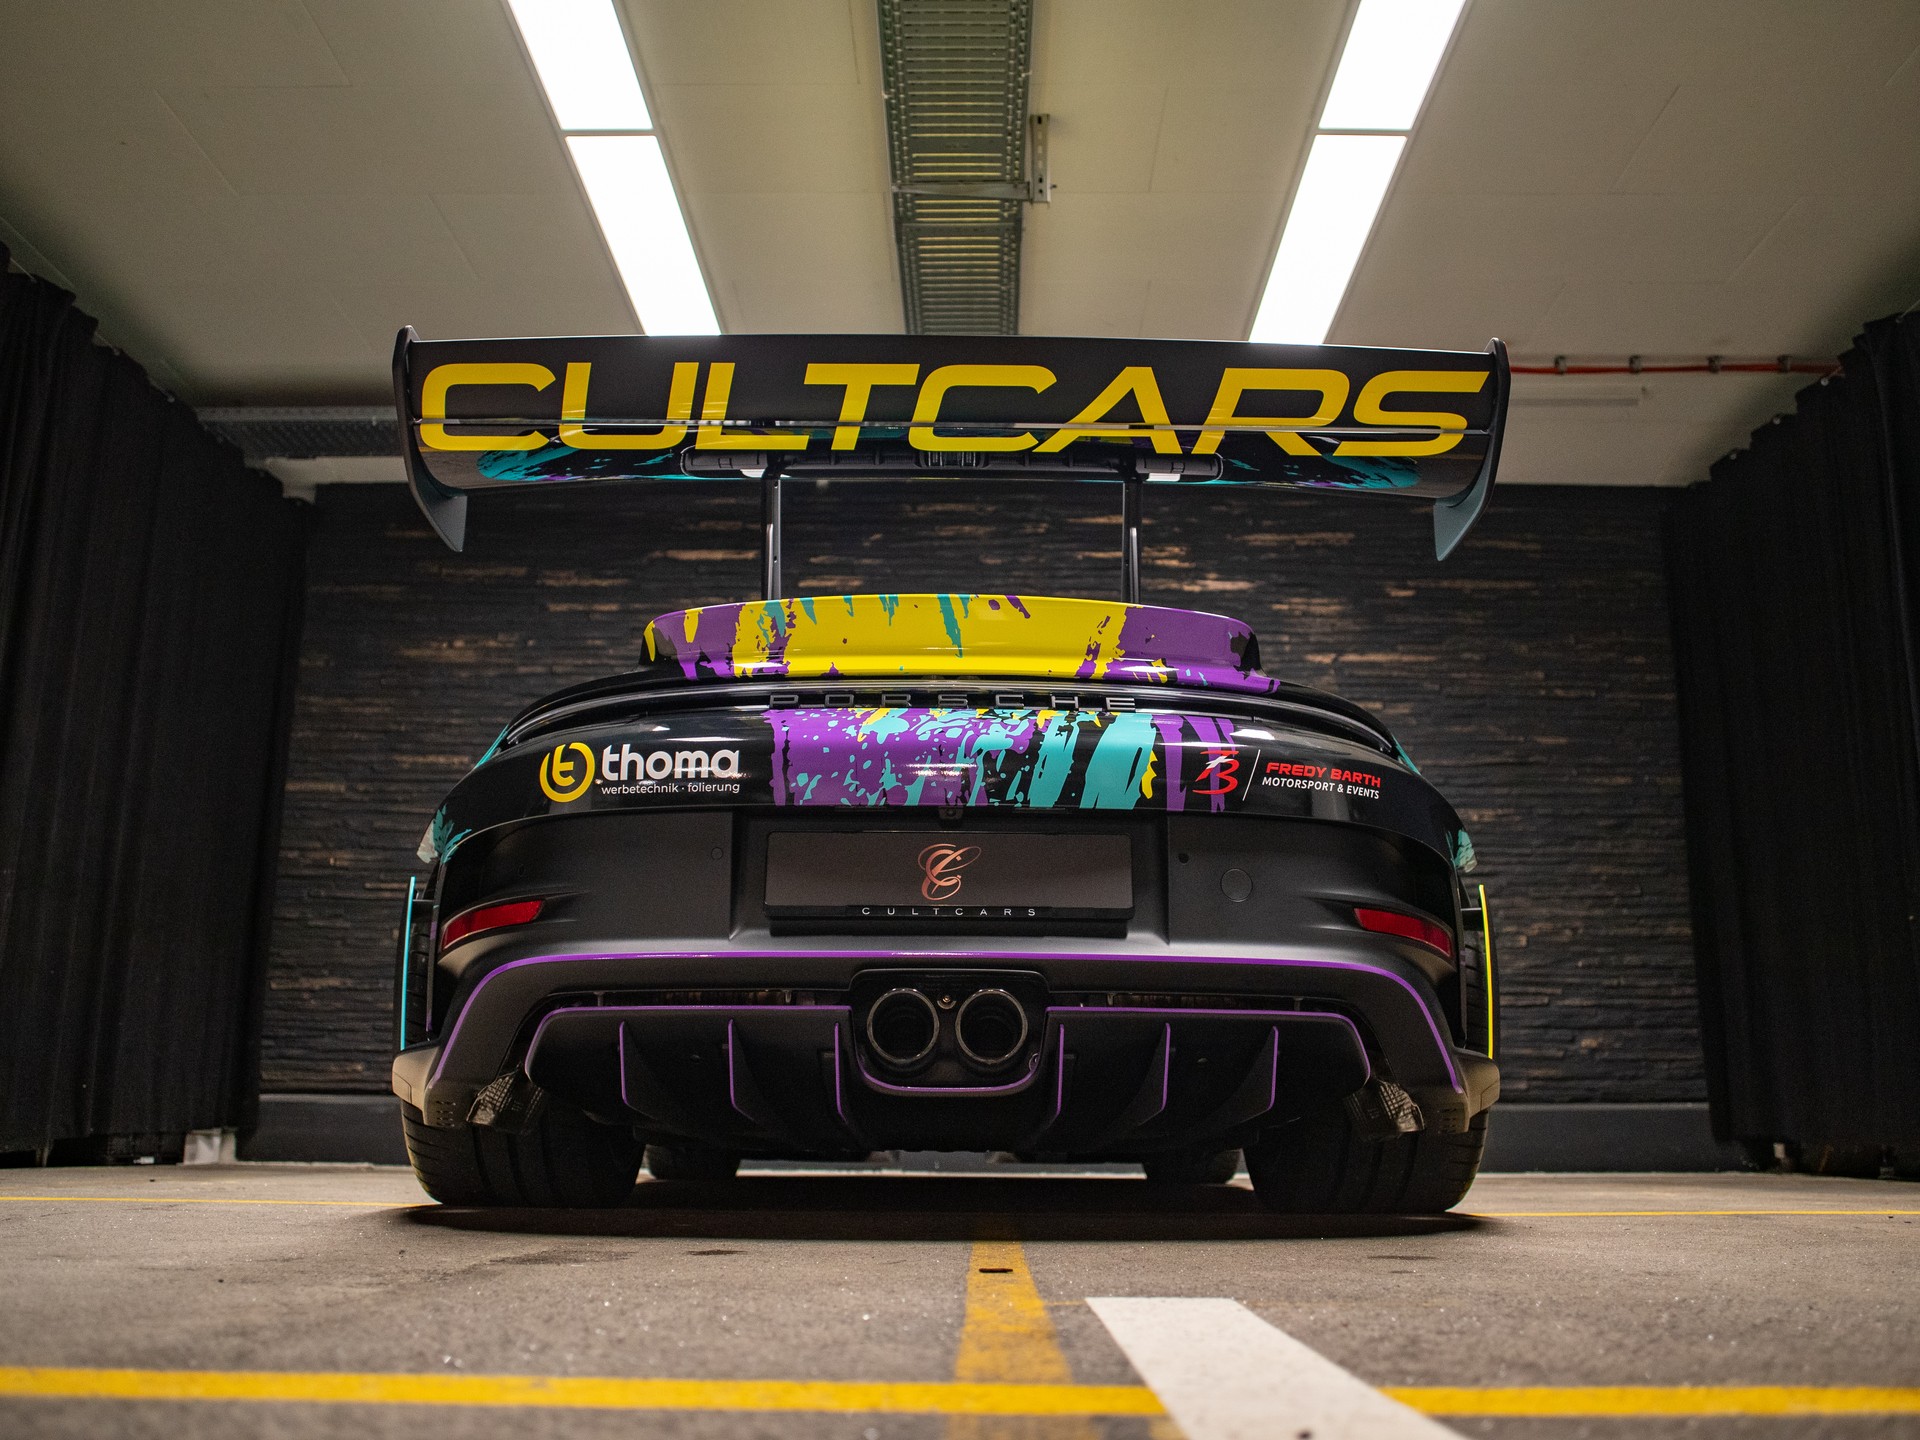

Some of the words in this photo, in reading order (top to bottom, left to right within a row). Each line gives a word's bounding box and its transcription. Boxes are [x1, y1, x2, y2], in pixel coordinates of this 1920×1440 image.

[420, 362, 1490, 457] CULTCARS
[769, 693, 1136, 713] PORSCHE
[602, 744, 740, 781] thoma
[1265, 762, 1328, 777] FREDY
[1330, 768, 1381, 788] BARTH
[601, 782, 679, 795] werbetechnik
[687, 781, 741, 793] folierung
[1261, 776, 1336, 793] MOTORSPORT
[1337, 784, 1344, 793] &
[1346, 785, 1380, 800] EVENTS
[861, 908, 1037, 916] CULTCARS
